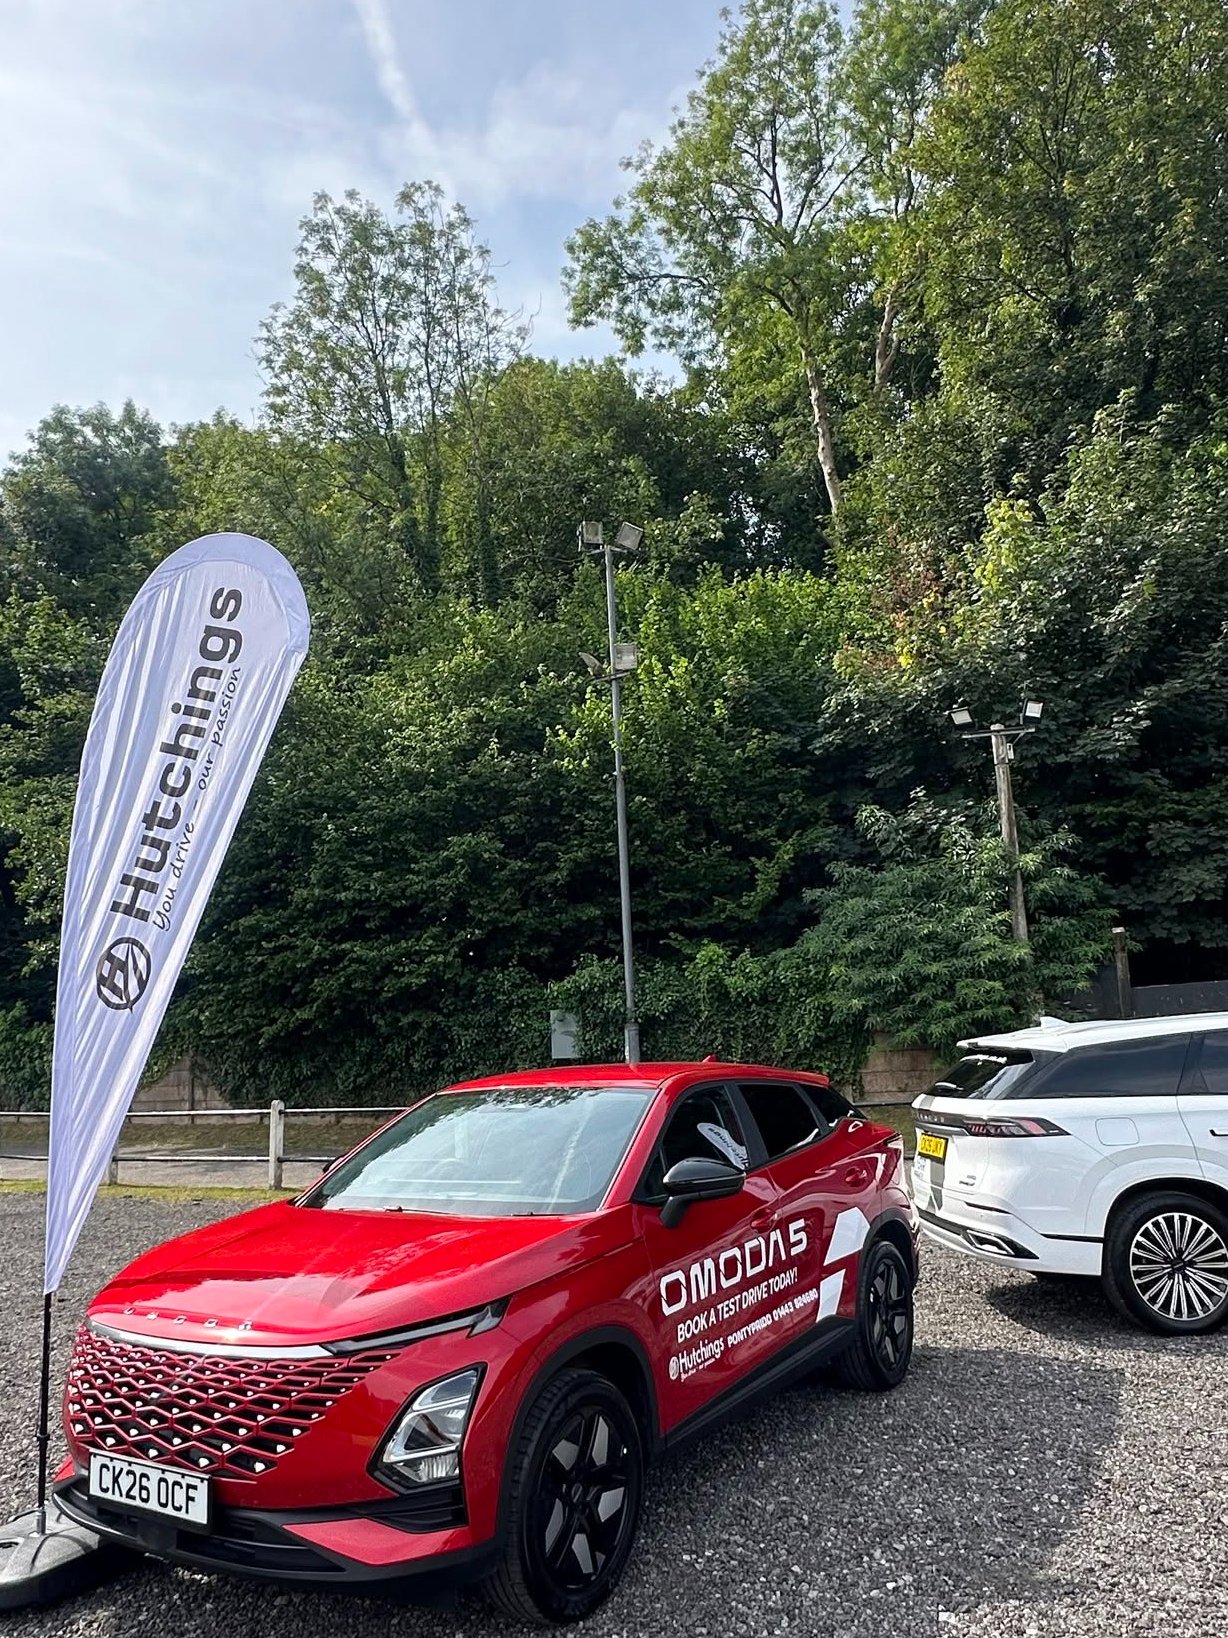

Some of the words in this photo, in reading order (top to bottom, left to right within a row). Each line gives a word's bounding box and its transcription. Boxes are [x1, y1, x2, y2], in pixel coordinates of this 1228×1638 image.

[110, 587, 243, 923] Hutchings
[152, 886, 178, 932] You
[170, 822, 195, 879] drive
[199, 752, 214, 791] our
[211, 667, 241, 747] passion
[660, 1229, 786, 1316] OMODA
[788, 1219, 808, 1257] 5
[677, 1311, 708, 1344] BOOK
[709, 1307, 717, 1327] A
[717, 1294, 741, 1321] TEST
[742, 1281, 768, 1310] DRIVE
[769, 1267, 798, 1295] TODAY!
[679, 1337, 725, 1373] Hutchings
[772, 1301, 794, 1322] 01443
[99, 1463, 150, 1504] CK26
[157, 1477, 198, 1515] OCF
